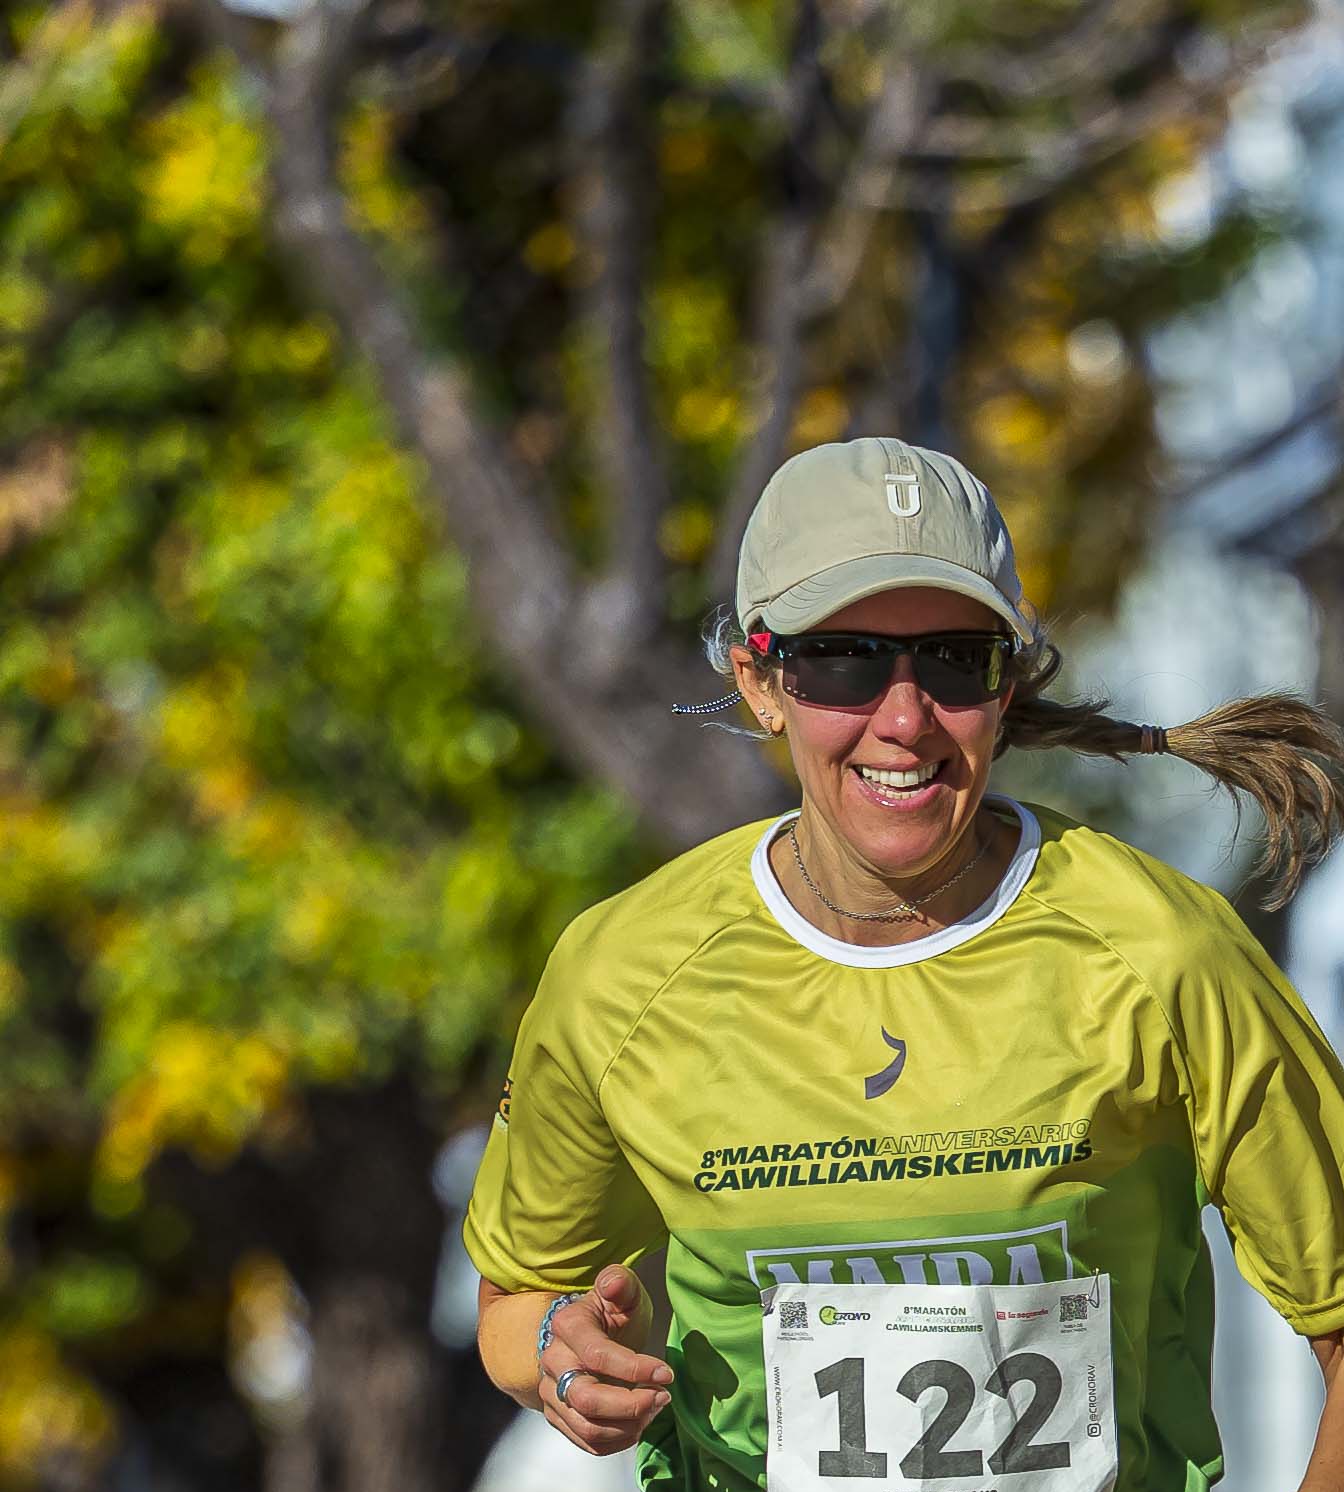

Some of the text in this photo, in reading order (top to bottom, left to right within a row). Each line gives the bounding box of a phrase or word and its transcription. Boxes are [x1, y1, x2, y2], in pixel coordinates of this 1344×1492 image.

[876, 1118, 1092, 1156] ANIVERSARIO
[693, 1138, 1093, 1194] CAWILLIAMSKEMMIS
[814, 1352, 1071, 1480] 122
